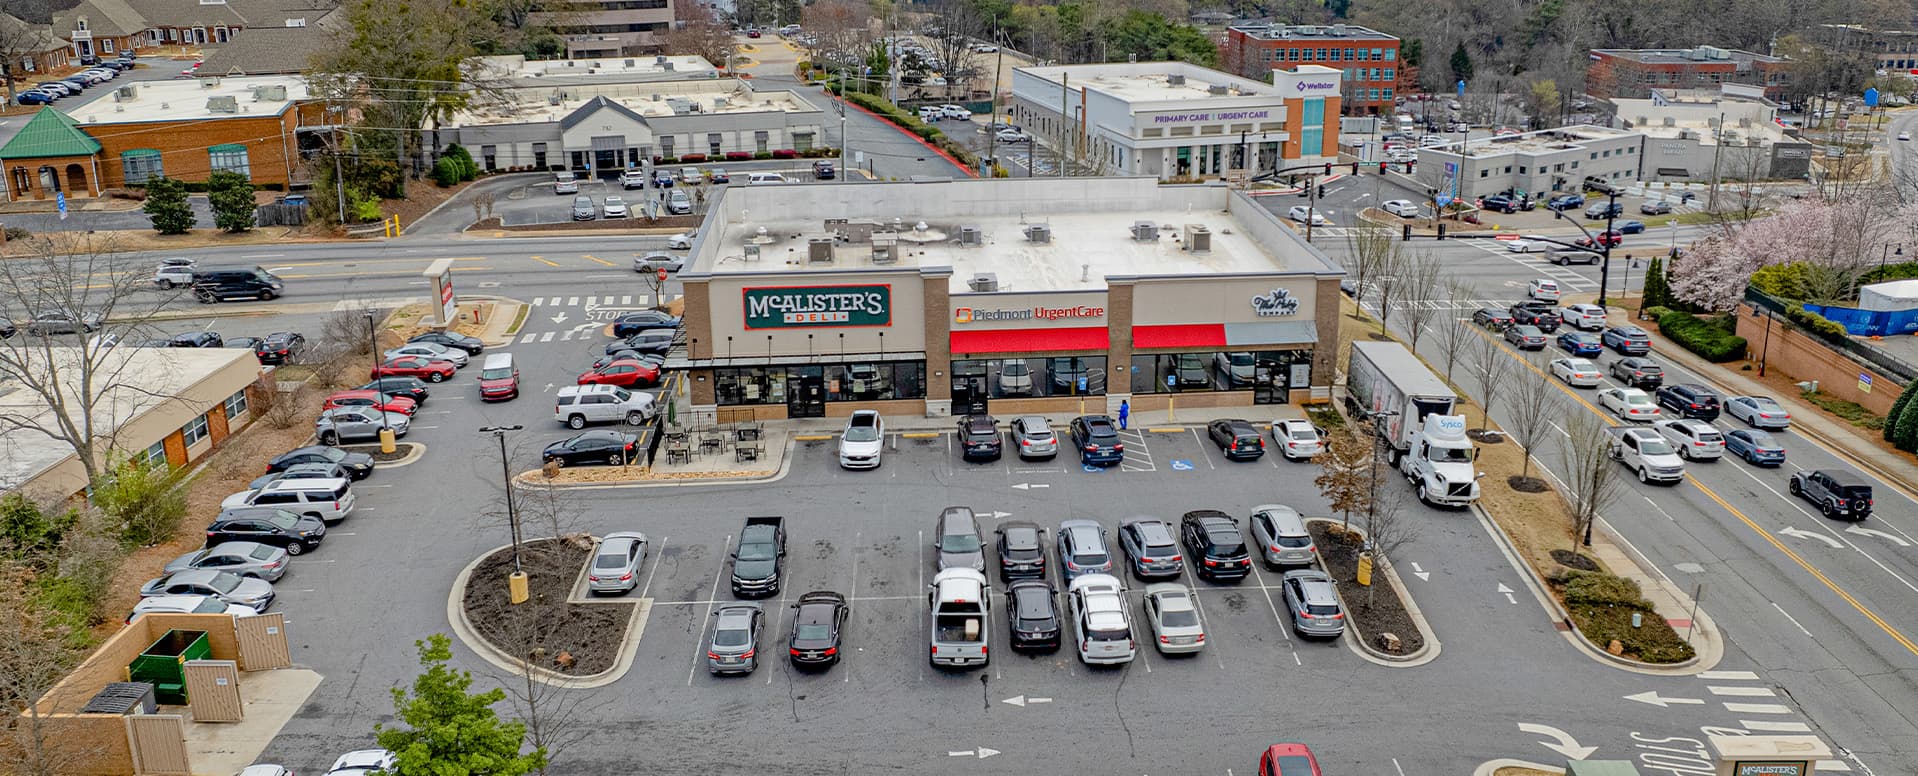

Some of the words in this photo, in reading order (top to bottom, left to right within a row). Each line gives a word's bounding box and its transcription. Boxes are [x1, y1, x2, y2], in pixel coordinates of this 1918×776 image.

[1306, 82, 1335, 90] Wellstar
[1155, 115, 1188, 123] PRIMARY
[1189, 113, 1210, 121] CARE
[1217, 112, 1247, 120] URGENT
[1248, 111, 1269, 119] CARE
[796, 313, 837, 322] DELI
[974, 309, 1032, 320] Piedmont
[1035, 306, 1104, 320] UrgentCare
[1440, 419, 1463, 429] Sysco
